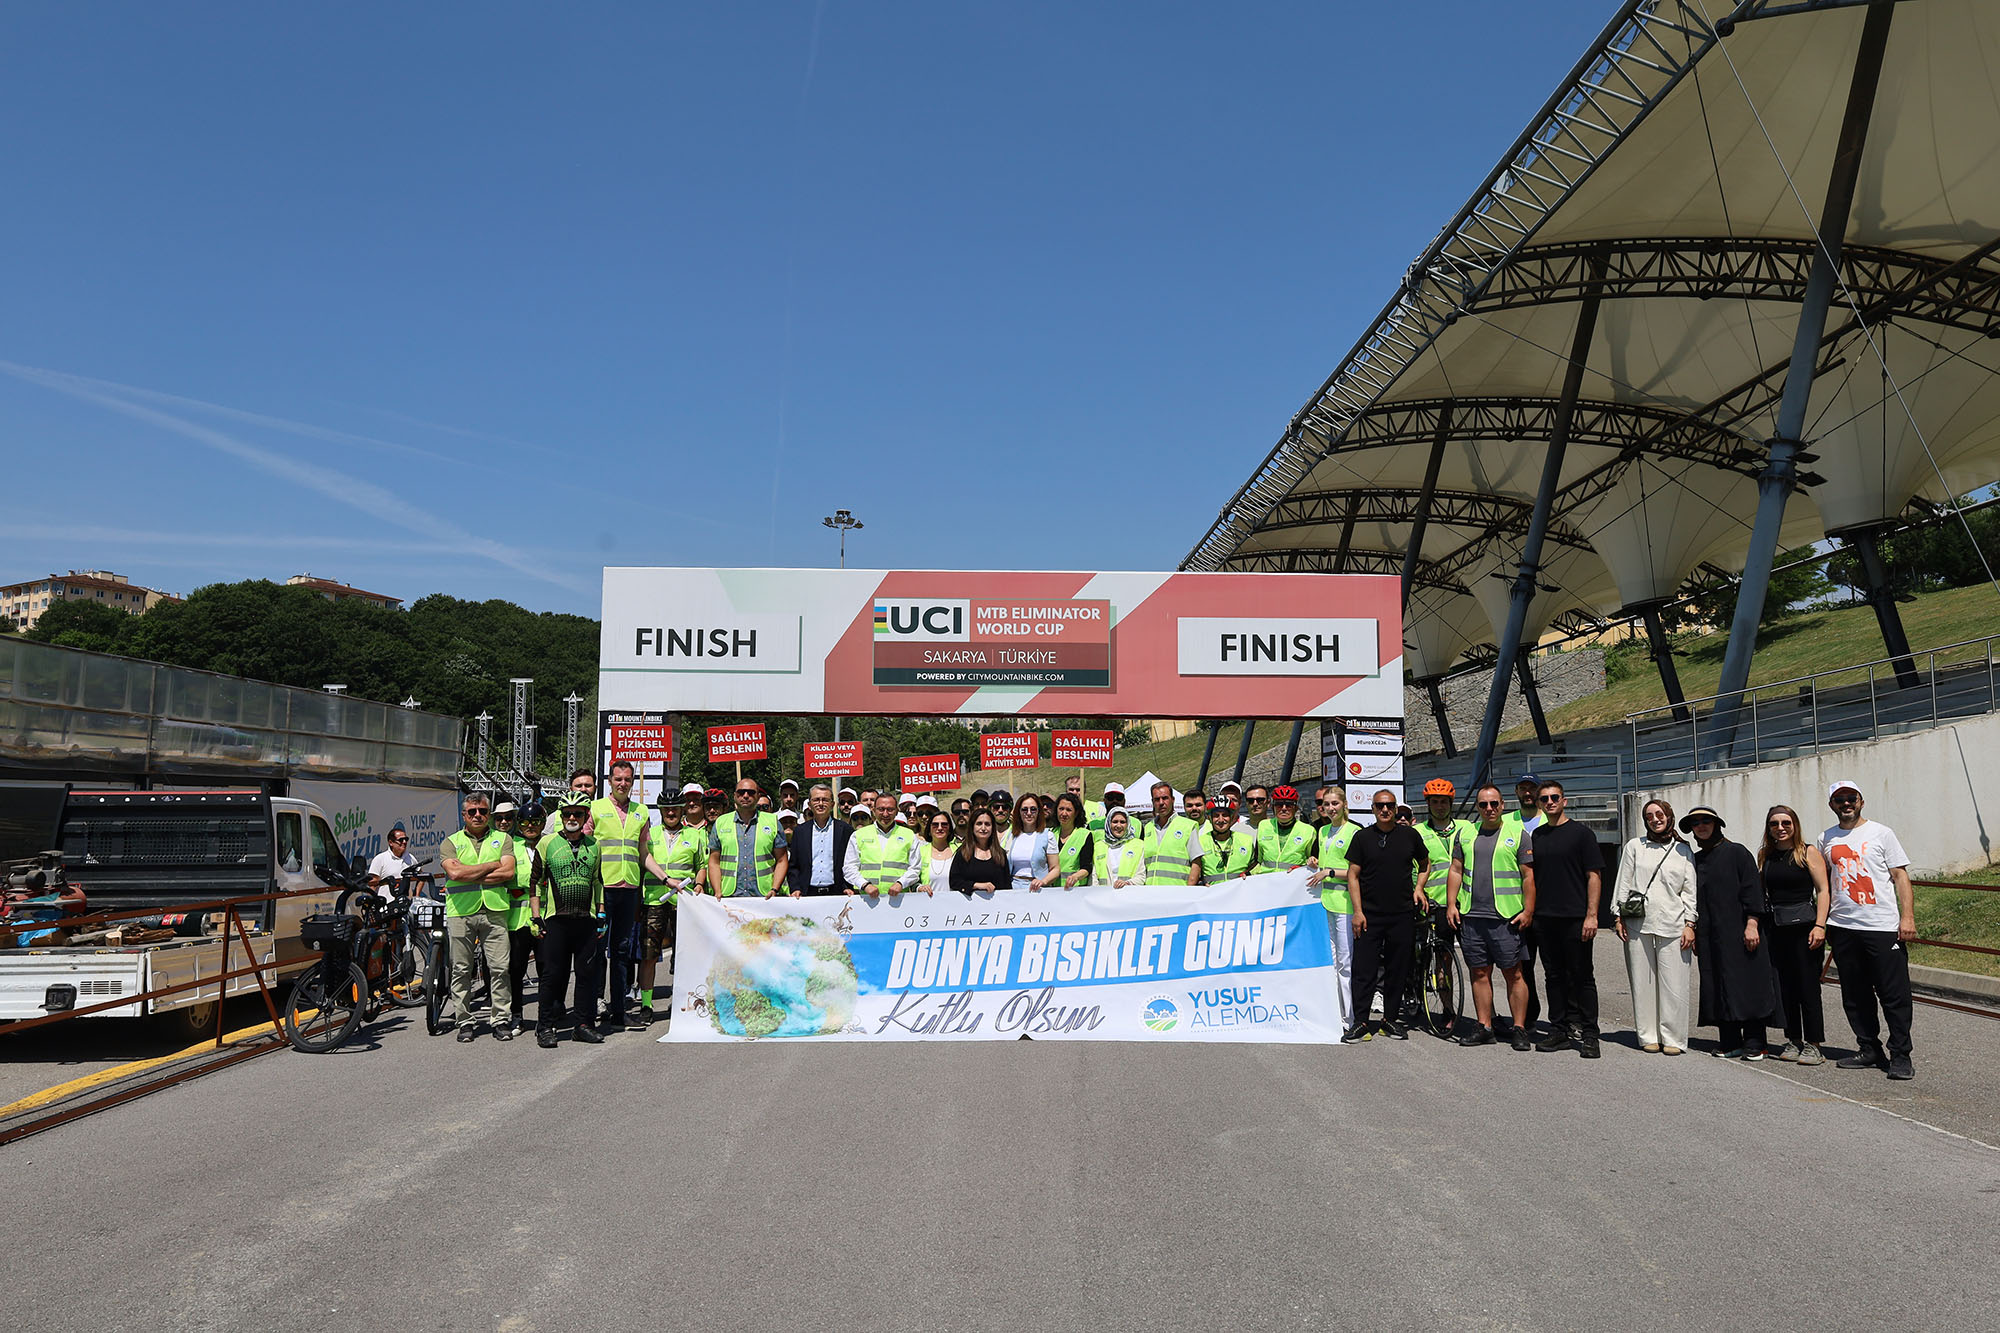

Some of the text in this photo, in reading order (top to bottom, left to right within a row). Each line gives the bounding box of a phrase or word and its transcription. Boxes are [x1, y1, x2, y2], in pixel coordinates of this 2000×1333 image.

[890, 606, 962, 634] UCI
[977, 607, 1101, 620] MTB ELIMINATOR
[977, 623, 1064, 635] WORLD CUP
[635, 627, 757, 658] FINISH
[1220, 633, 1340, 663] FINISH
[923, 648, 1057, 664] SAKARYA TÜRKİYE
[916, 673, 1064, 682] POWERED BY CITYMOUNTAINBIKE.COM
[618, 728, 665, 738] DÜZENLİ
[710, 731, 762, 743] SAĞLIKLI
[618, 739, 665, 749] FİZİKSEL
[986, 736, 1031, 747] DÜZENLİ
[1055, 735, 1110, 748] SAĞLIKLI
[616, 750, 668, 759] AKTİVİTE YAPIN
[712, 742, 763, 755] BESLENİN
[987, 747, 1031, 758] FİZİKSEL
[1055, 748, 1110, 761] BESLENİN
[810, 760, 858, 768] OLMADIĞINIZI
[903, 761, 957, 773] SAĞLIKLI
[985, 758, 1034, 768] AKTİVİTE YAPIN
[904, 772, 958, 785] BESLENİN
[410, 814, 436, 830] YUSUF
[410, 831, 446, 848] ALEMDAR
[904, 911, 1051, 929] 03 HAZİRAN
[886, 935, 1013, 989] DÜNYA
[1183, 915, 1288, 972] GÜNÜ
[1188, 986, 1262, 1009] YUSUF
[874, 985, 1106, 1035] Kutlu Olsun
[1190, 1004, 1300, 1029] ALEMDAR
